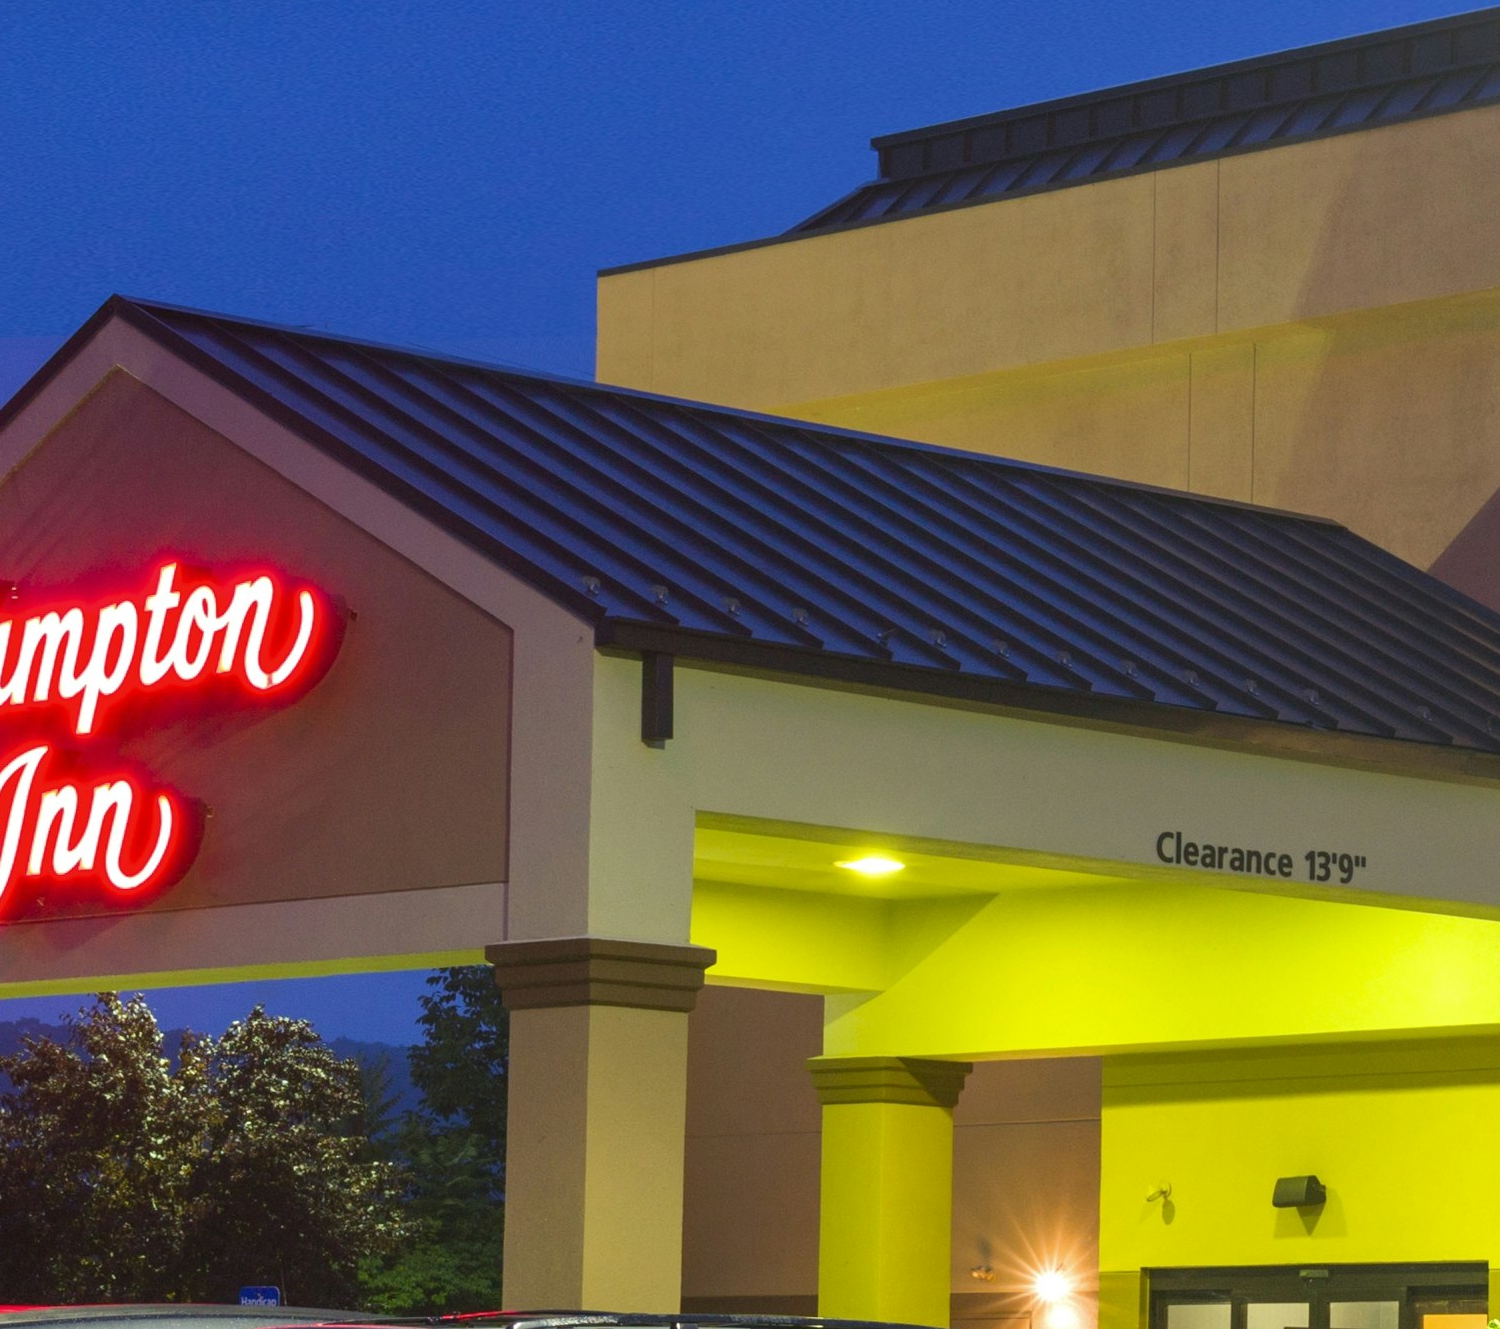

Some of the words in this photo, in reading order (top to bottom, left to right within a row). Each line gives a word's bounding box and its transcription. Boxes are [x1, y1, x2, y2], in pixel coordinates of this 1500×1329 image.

[1156, 831, 1293, 877] Clearance
[1305, 850, 1367, 884] 13'9"
[241, 1297, 277, 1307] Handicap
